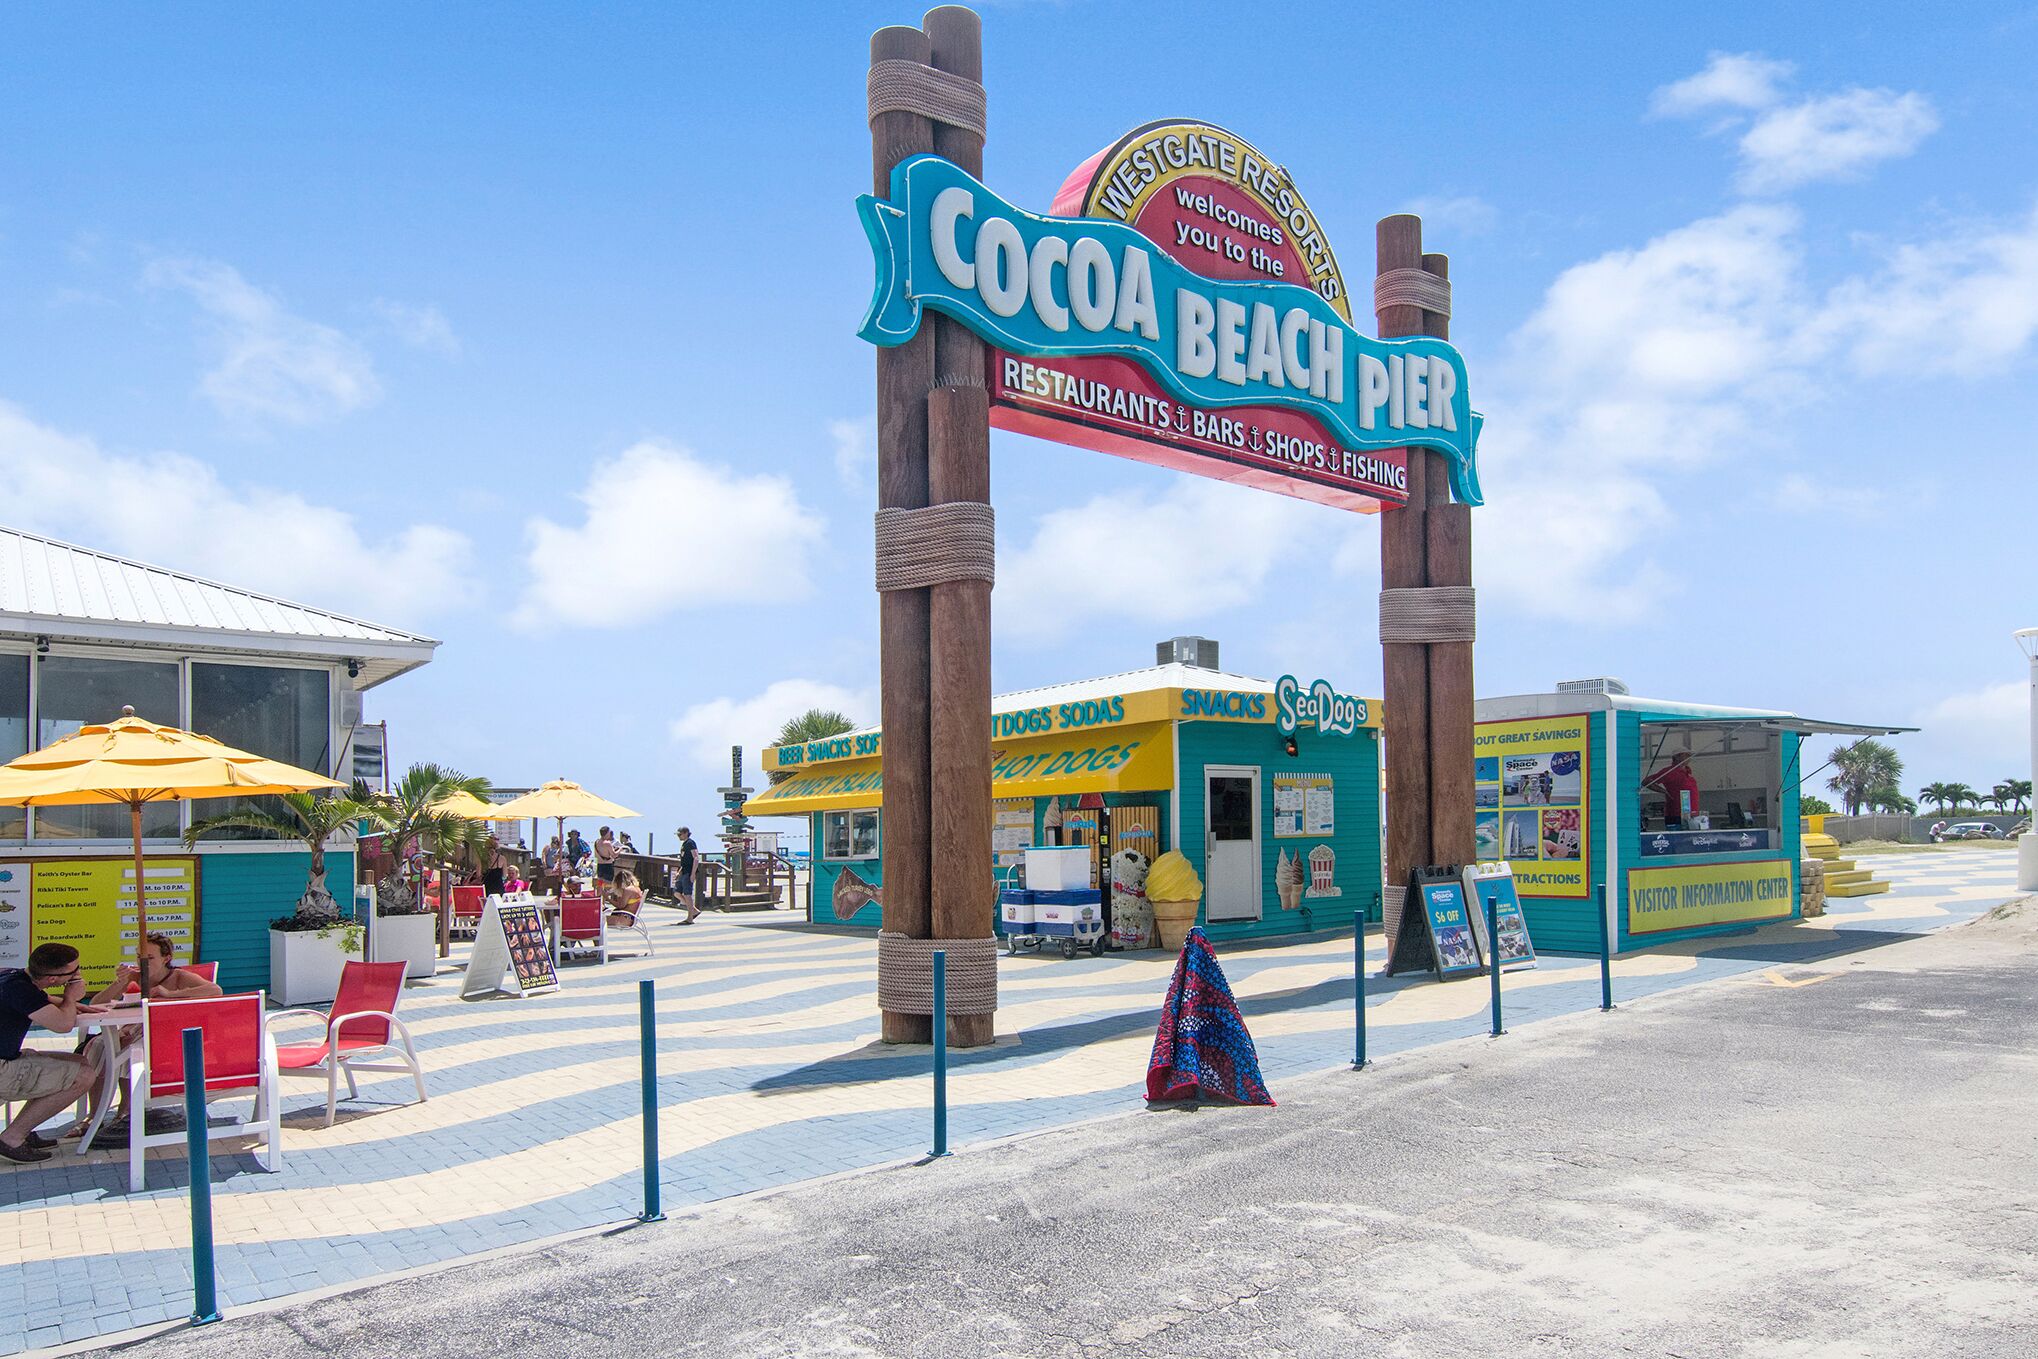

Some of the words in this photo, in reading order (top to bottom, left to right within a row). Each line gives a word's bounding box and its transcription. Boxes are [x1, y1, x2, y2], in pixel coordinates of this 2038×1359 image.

[1100, 133, 1237, 220] WESTGATE
[1242, 153, 1341, 301] RESORTS
[1175, 186, 1284, 246] welcomes
[1175, 220, 1219, 253] you
[1224, 236, 1246, 263] to
[1250, 248, 1284, 277] the
[930, 186, 1161, 342] COCOA
[1176, 287, 1344, 405] BEACH
[1357, 352, 1458, 434] PIER
[1003, 356, 1170, 428] RESTAURANTS
[1193, 410, 1244, 448] BARS
[1265, 430, 1325, 468] SHOPS
[1342, 451, 1407, 490] FISHING
[1001, 706, 1051, 737] DOGS
[1059, 695, 1124, 728] SODAS
[1181, 688, 1266, 719] SNACKS
[778, 745, 804, 766] BEER
[807, 737, 852, 762] SNACKS
[855, 733, 881, 756] SOF
[1499, 732, 1531, 744] GREAT
[1534, 728, 1581, 741] SAVINGS!
[992, 752, 1052, 780] HOT
[1040, 741, 1141, 777] DOGS
[1506, 760, 1538, 770] Space
[1551, 754, 1579, 767] NASA
[1431, 892, 1454, 901] Space
[1633, 886, 1678, 913] VISITOR
[1682, 880, 1753, 908] INFORMATION
[1756, 877, 1789, 900] CENTER
[1435, 911, 1446, 923] $6
[1447, 910, 1460, 922] OFF
[1443, 936, 1462, 946] NASA
